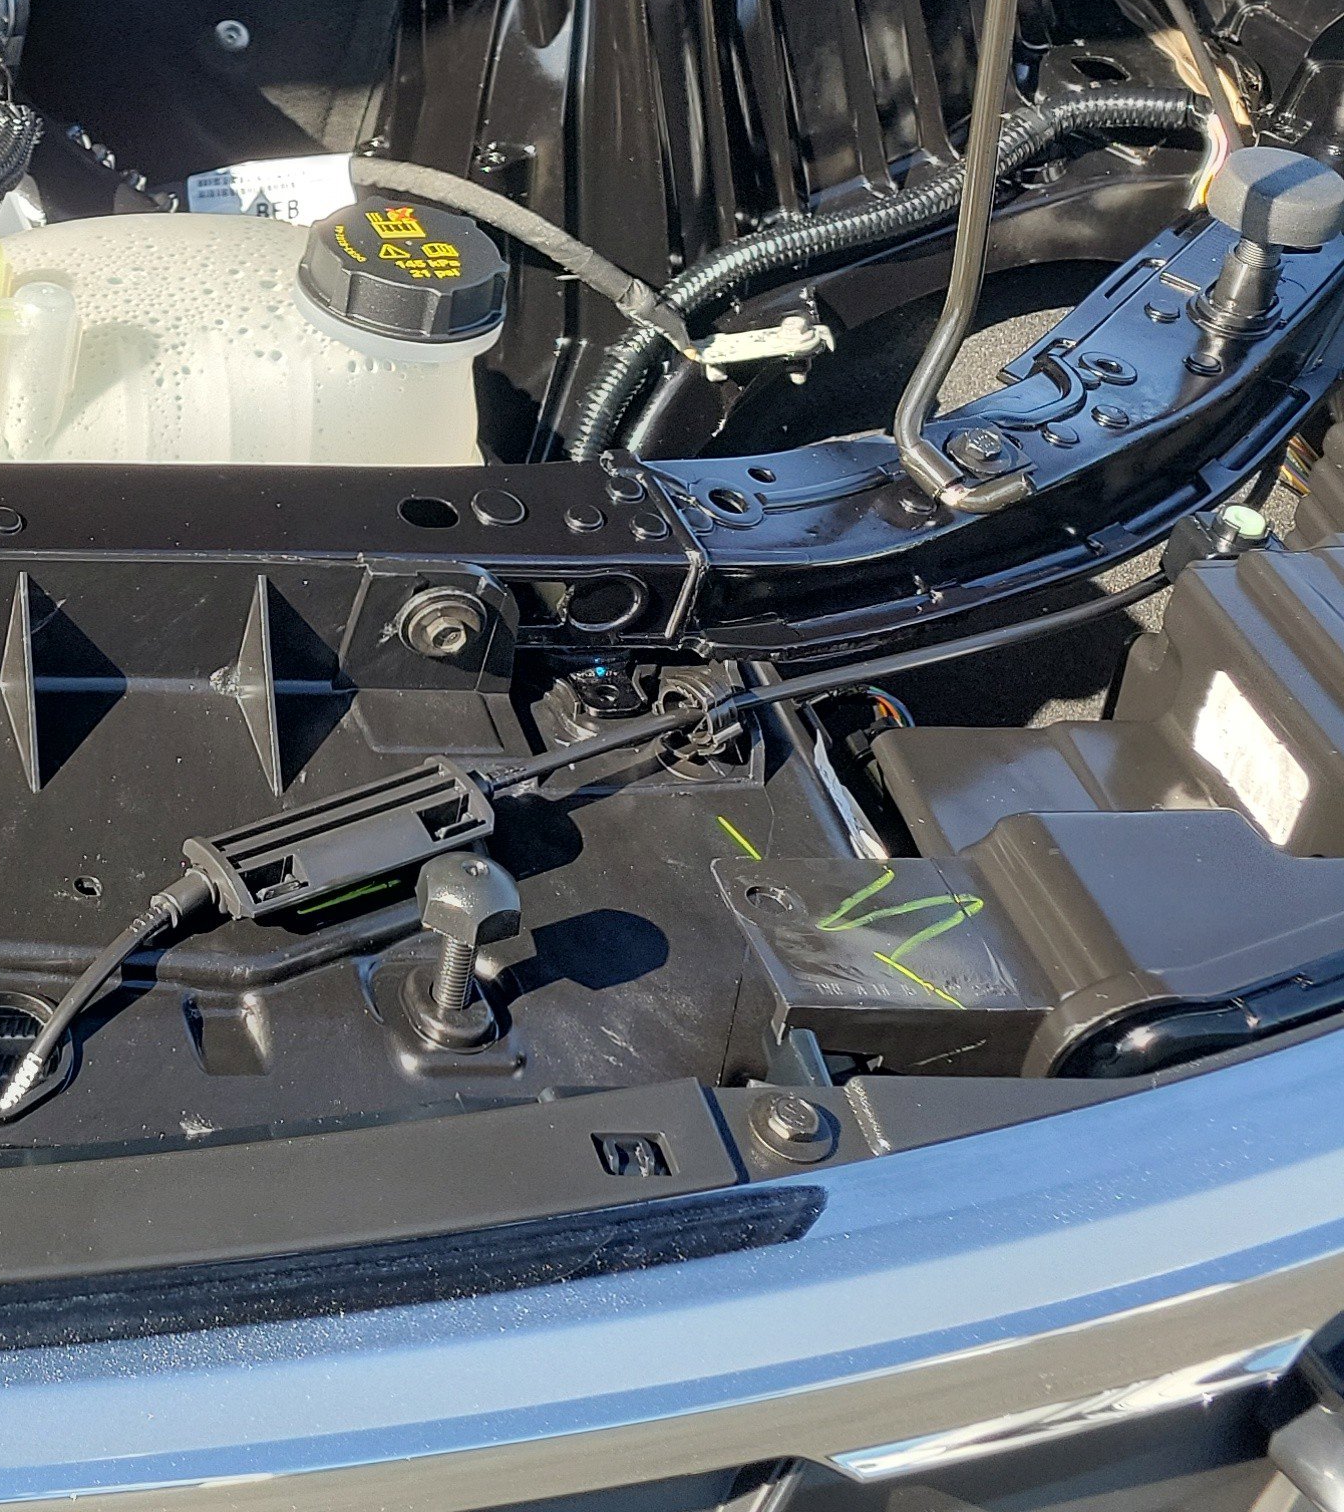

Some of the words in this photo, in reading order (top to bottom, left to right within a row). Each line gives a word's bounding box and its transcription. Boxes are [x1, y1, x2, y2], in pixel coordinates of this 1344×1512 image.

[395, 260, 426, 268] 145
[409, 269, 431, 278] 21
[434, 269, 461, 279] psi
